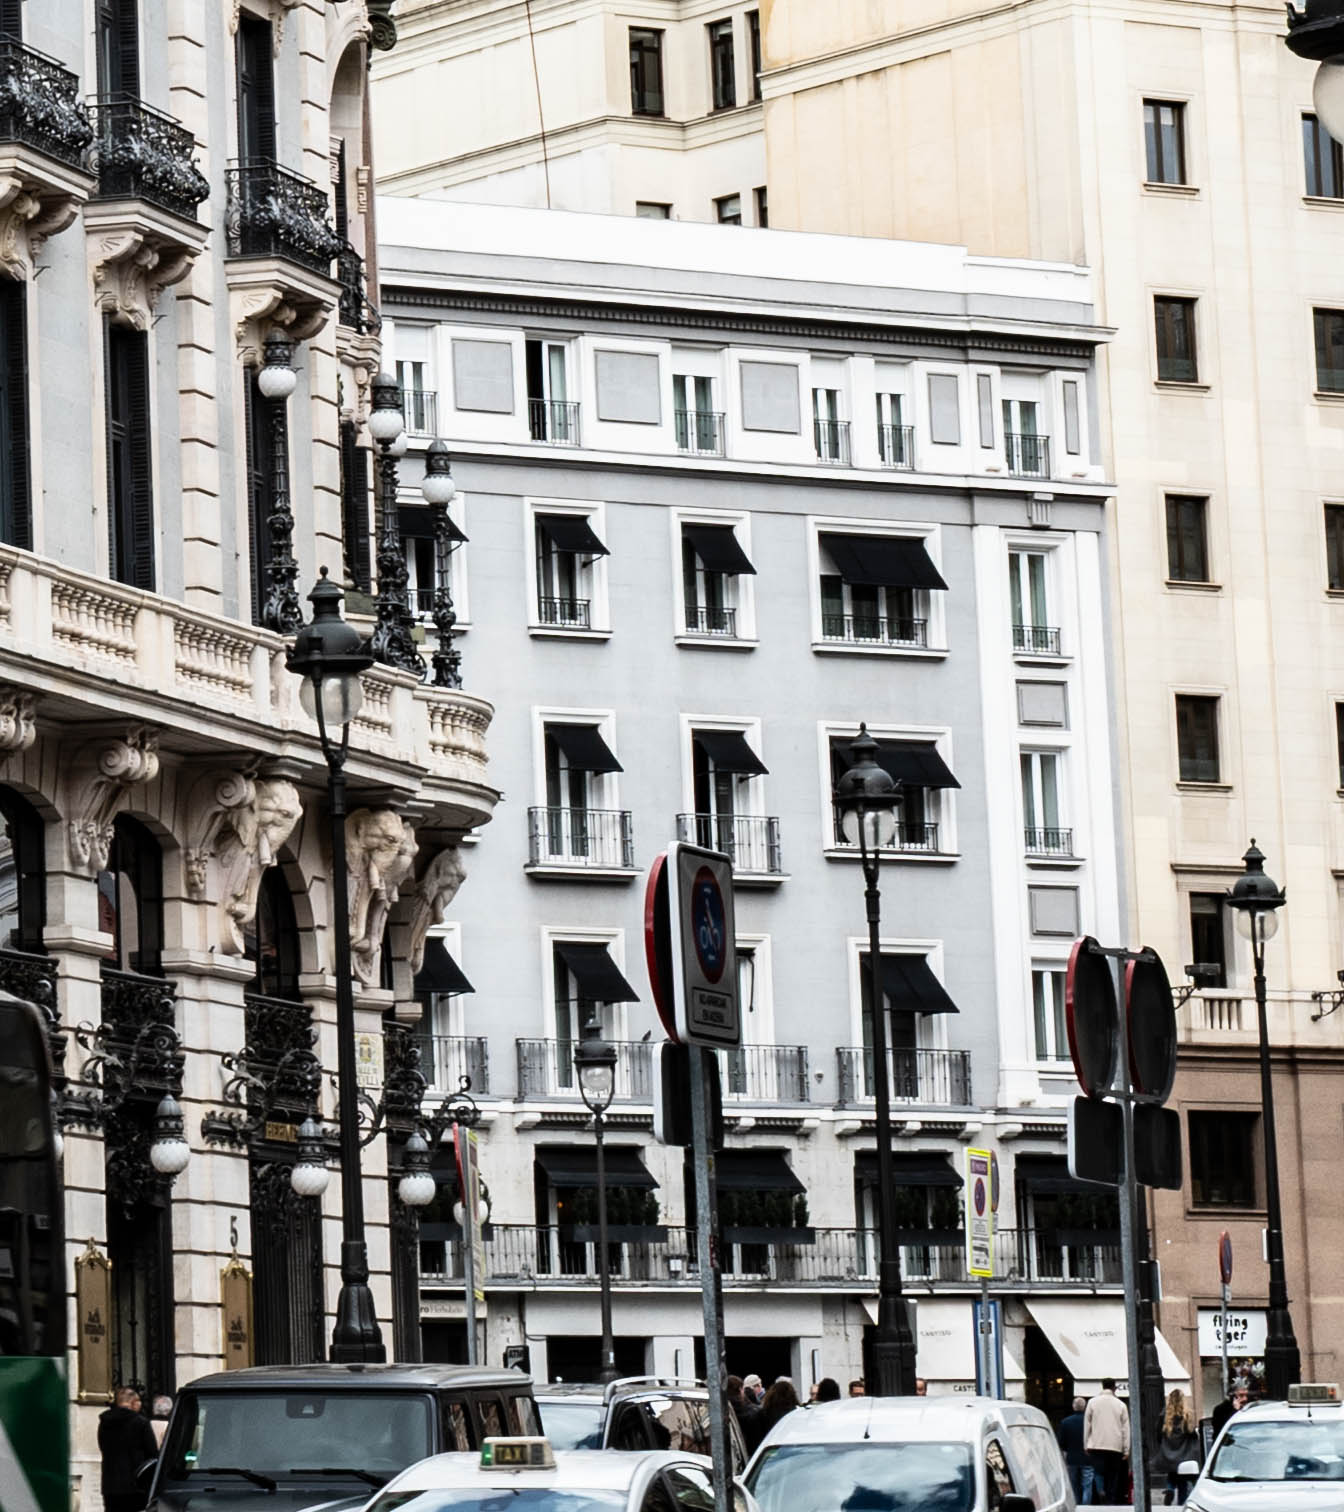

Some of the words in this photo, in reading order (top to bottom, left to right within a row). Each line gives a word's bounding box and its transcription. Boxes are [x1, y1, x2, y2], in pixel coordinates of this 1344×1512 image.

[229, 1215, 240, 1249] 5
[1215, 1329, 1247, 1344] tger
[953, 1384, 976, 1392] CASTI
